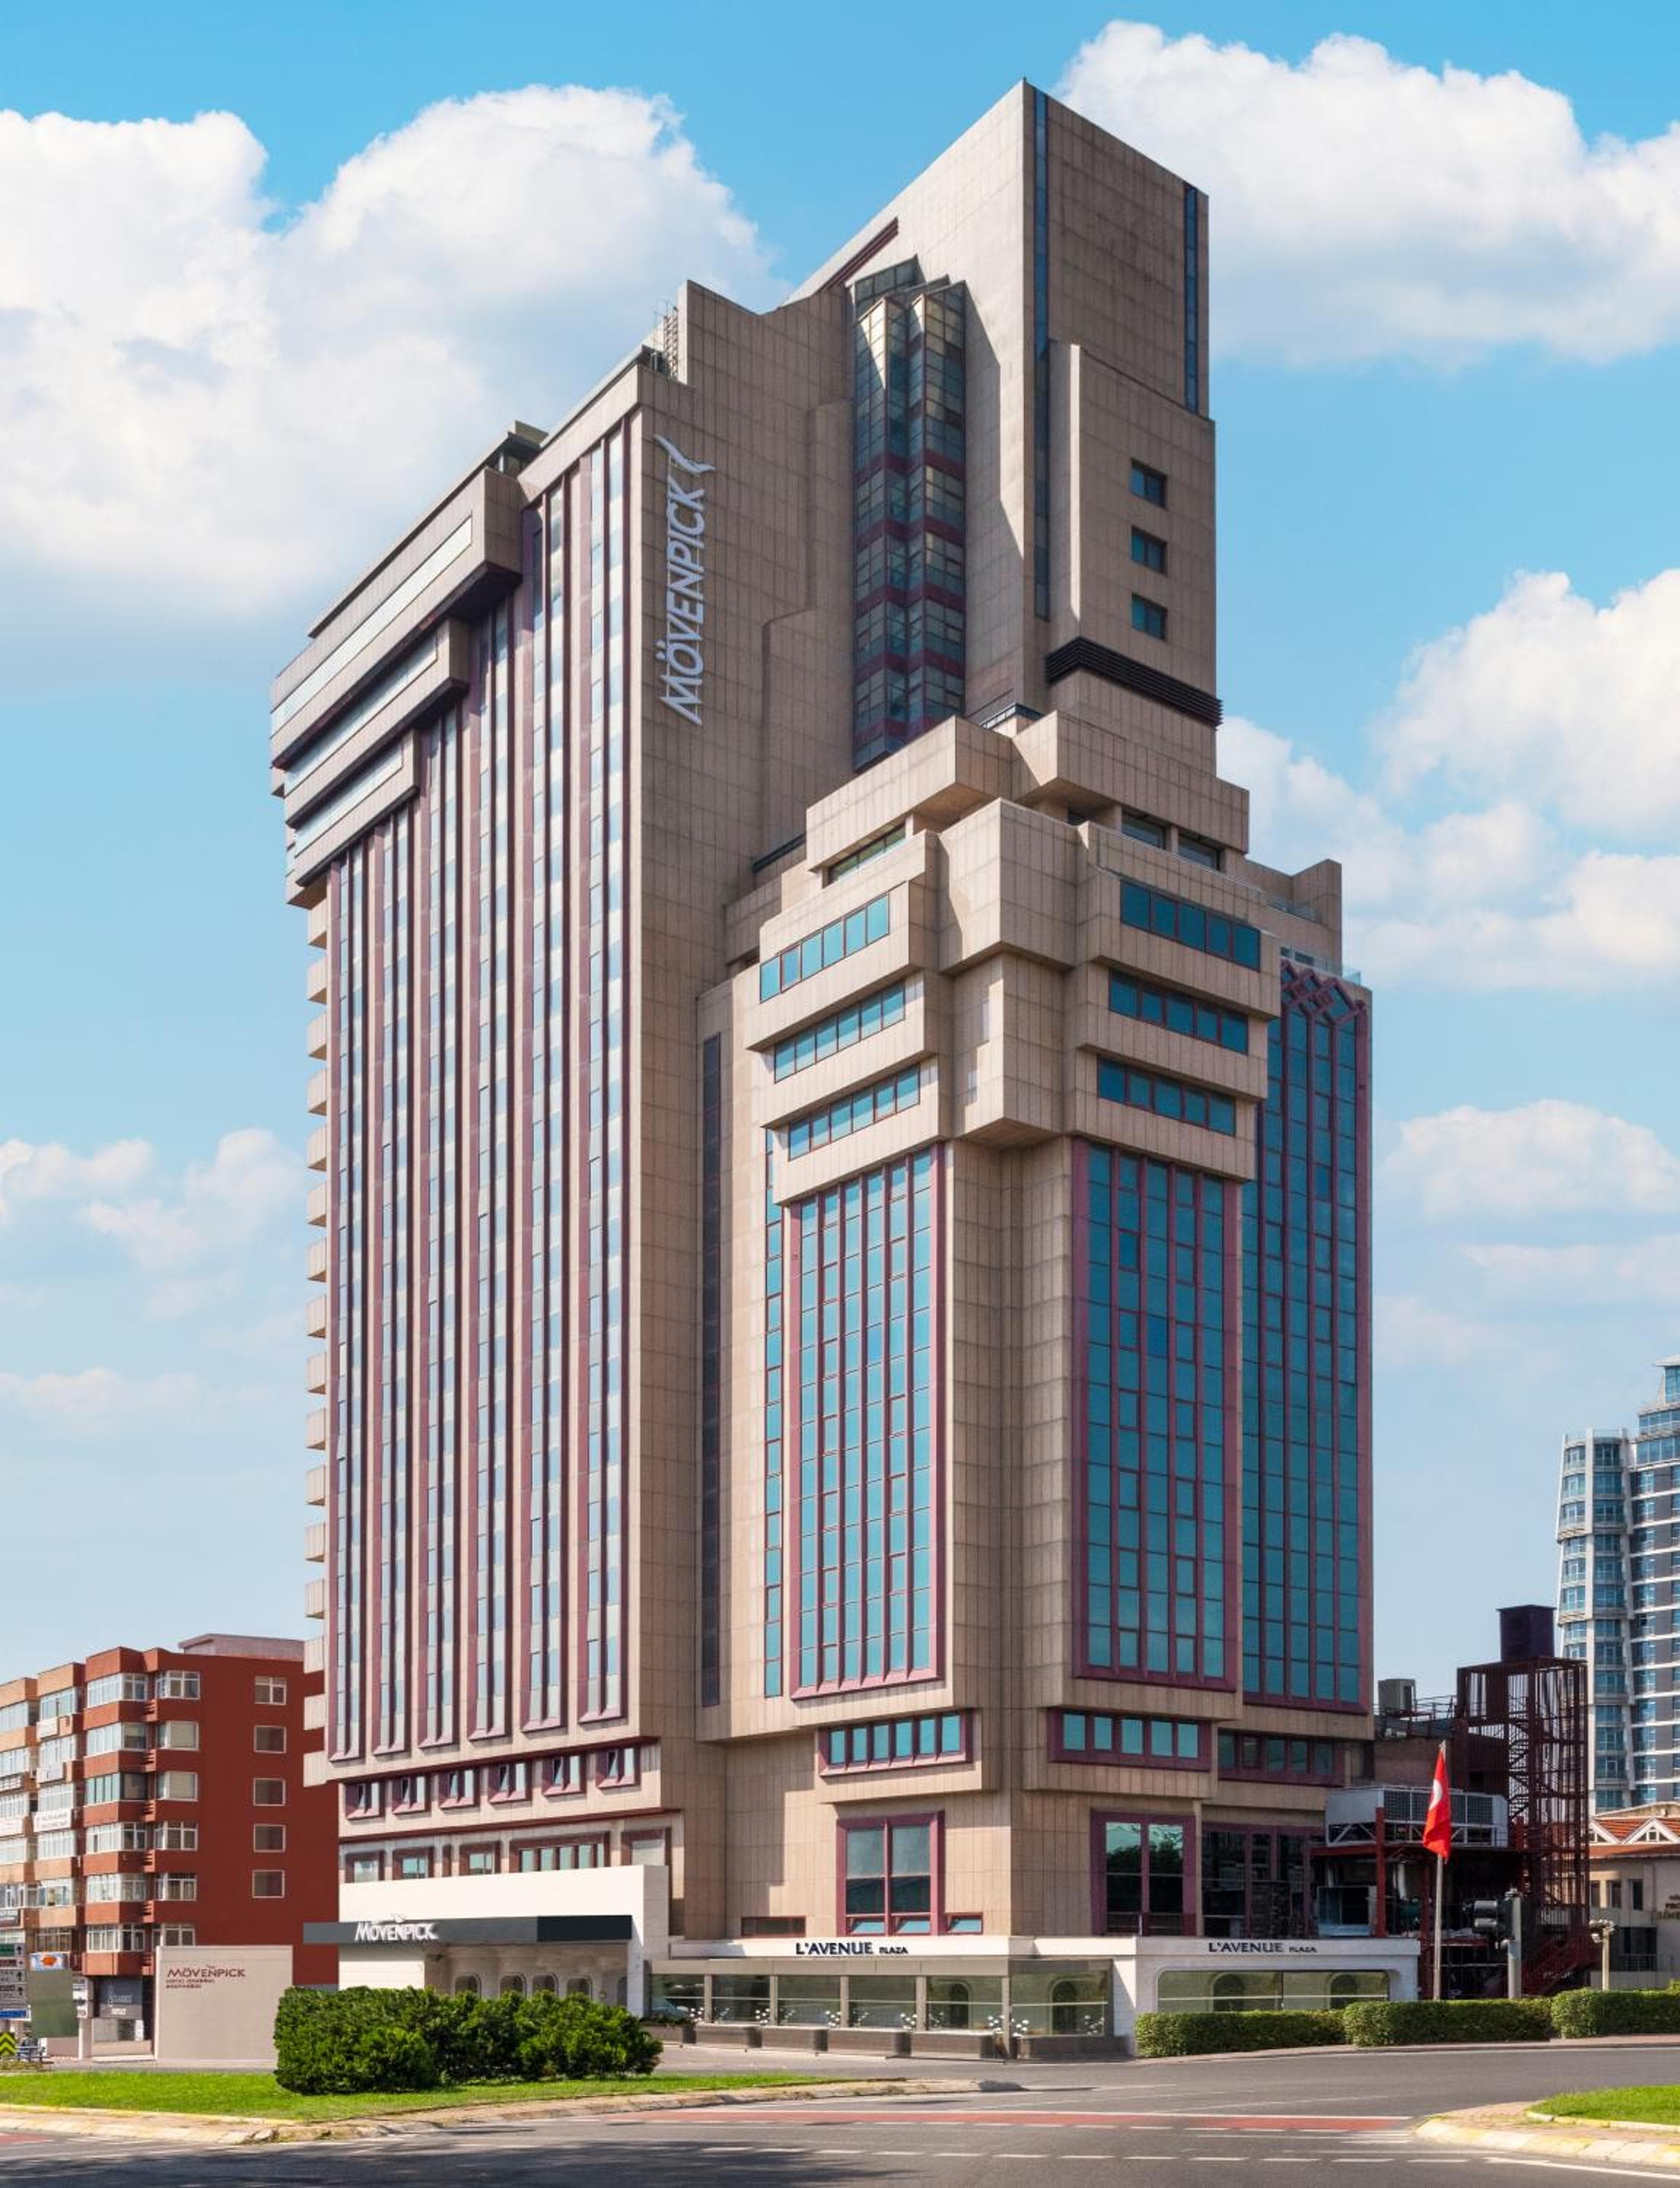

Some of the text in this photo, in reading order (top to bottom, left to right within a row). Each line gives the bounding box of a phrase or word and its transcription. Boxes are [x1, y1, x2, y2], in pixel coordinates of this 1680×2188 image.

[656, 474, 705, 726] MÖVENPICK
[796, 1941, 909, 1955] L'AVENUE PLAZA
[1208, 1942, 1284, 1953] L'AVENUE
[167, 1967, 246, 1977] MÖVENPICK
